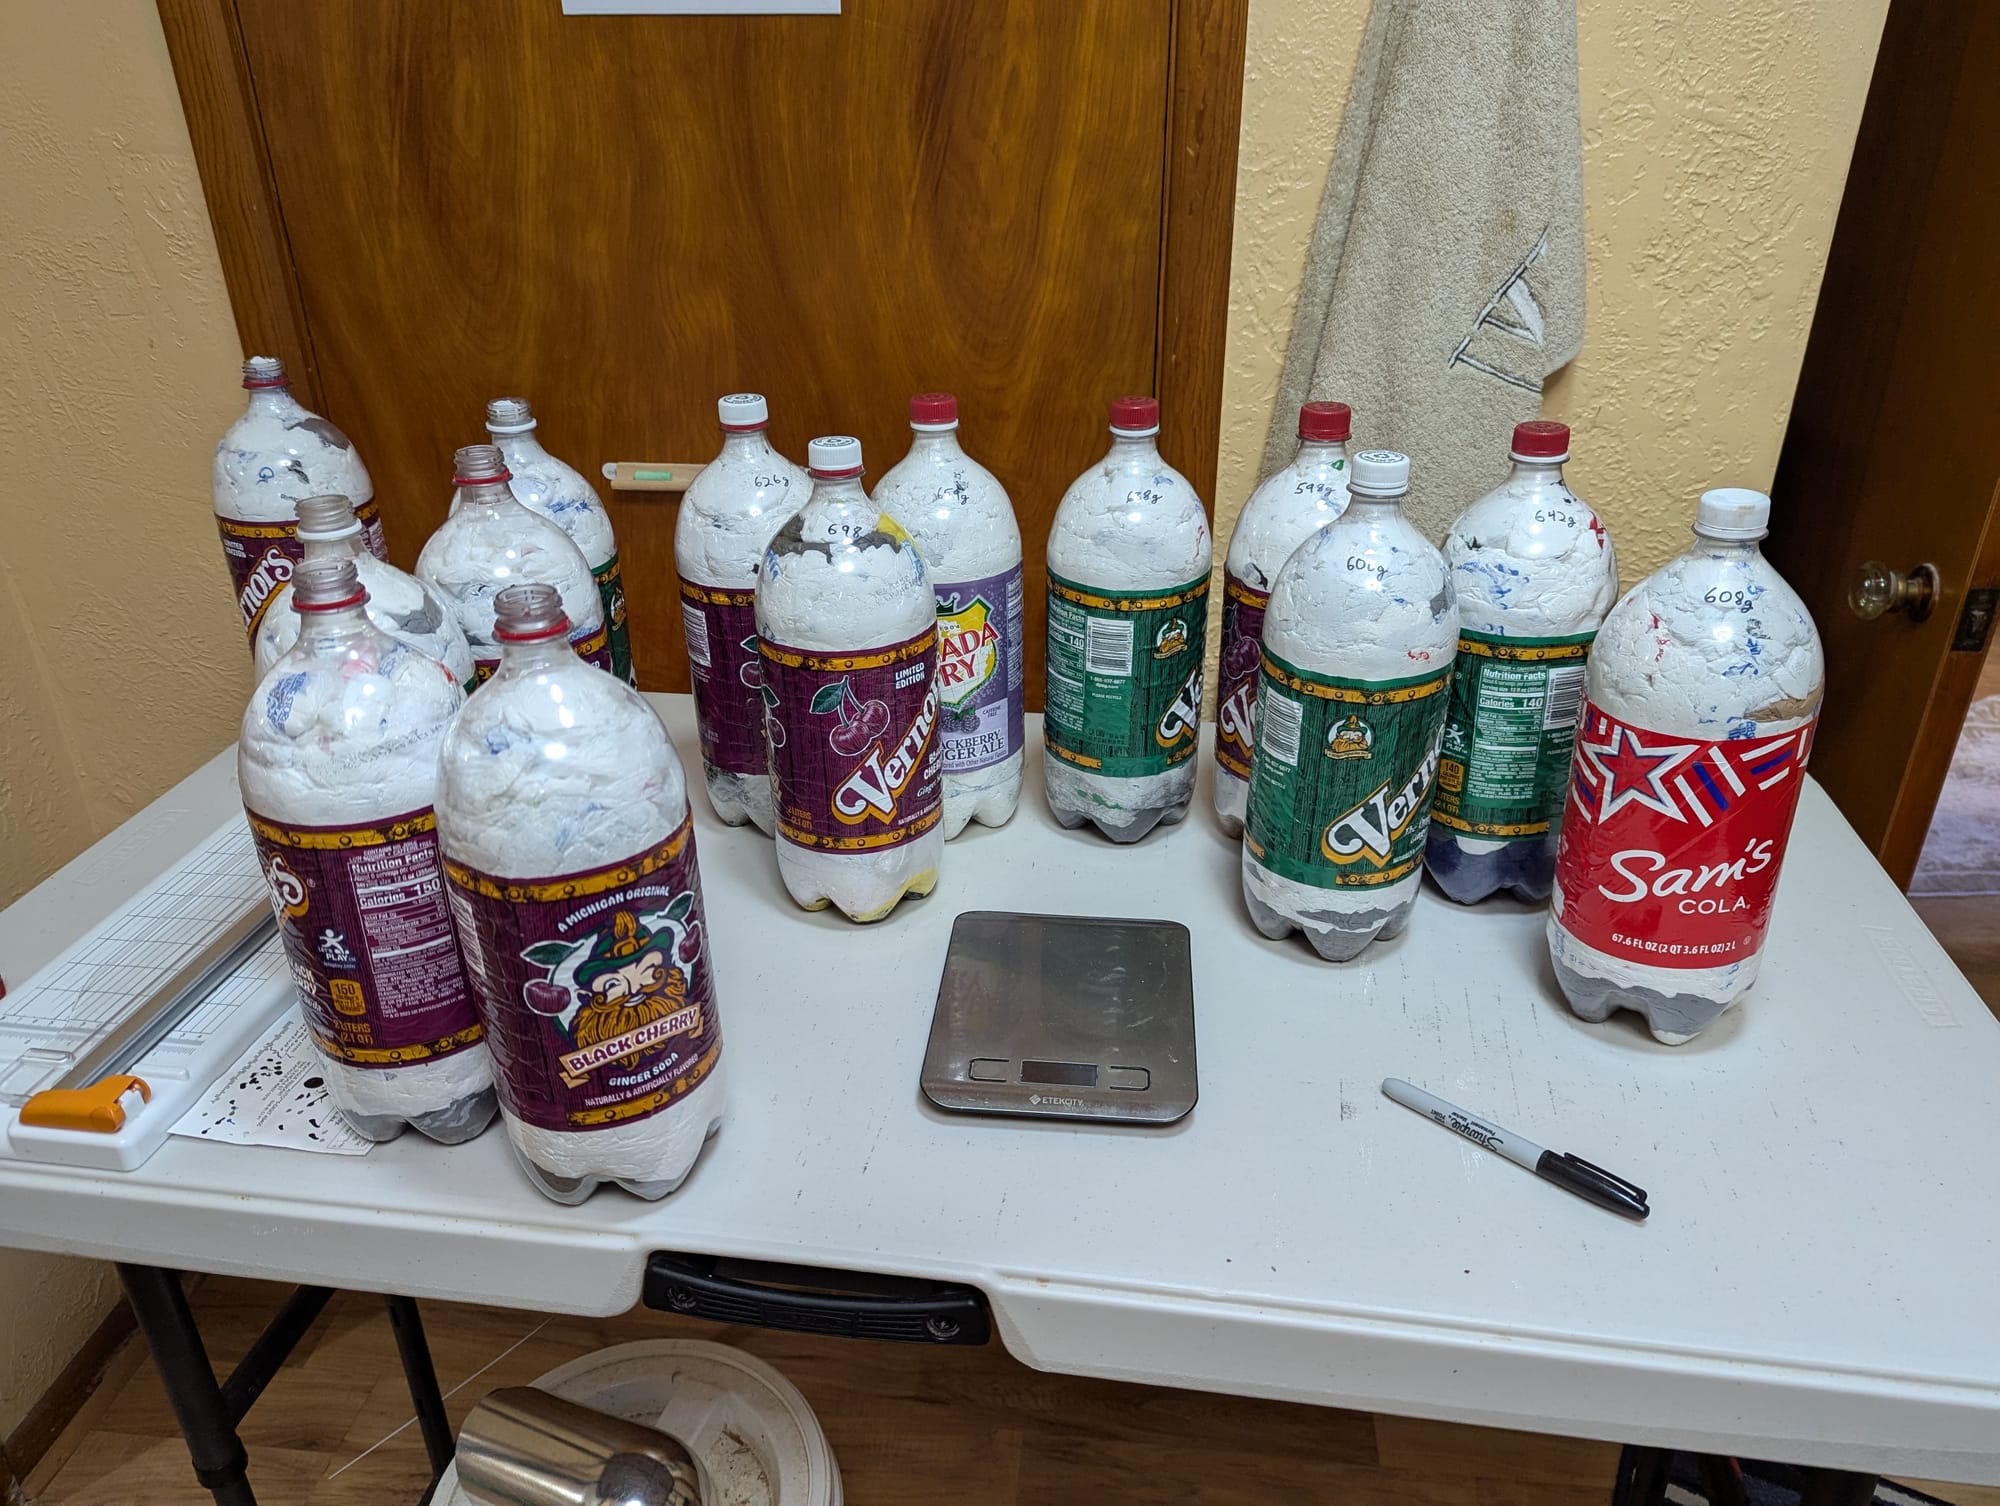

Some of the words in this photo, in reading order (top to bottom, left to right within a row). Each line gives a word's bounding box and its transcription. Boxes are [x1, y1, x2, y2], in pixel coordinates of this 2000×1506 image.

[754, 474, 790, 488] 626g
[1294, 482, 1336, 497] 598g
[1534, 510, 1577, 529] 642g
[827, 523, 863, 539] 698
[1704, 586, 1754, 614] 608g
[941, 622, 1000, 663] ADA
[1069, 636, 1084, 648] 140
[895, 661, 925, 682] LIMITED
[939, 654, 976, 688] RY
[1483, 668, 1524, 681] Nutrition
[1523, 670, 1546, 680] Facts
[895, 672, 925, 690] EDITION
[1479, 697, 1515, 708] Calories
[1522, 698, 1543, 708] 140
[941, 729, 1001, 750] ACKBERRY
[979, 736, 1006, 757] ALE
[1445, 762, 1460, 775] 140
[351, 857, 403, 875] Nutrition
[405, 848, 435, 862] Facts
[1598, 837, 1774, 903] Sam's
[359, 892, 406, 907] Calories
[411, 878, 441, 898] 150
[556, 920, 568, 934] A
[565, 892, 625, 927] MICHIGAN
[625, 884, 671, 900] ORIGINAL
[1678, 895, 1746, 915] COLA
[1611, 932, 1633, 946] 67.6
[1632, 937, 1644, 949] FL
[1644, 940, 1658, 952] OZ
[1658, 942, 1668, 954] (2
[1669, 943, 1683, 955] QT
[1683, 943, 1699, 955] 3.6
[1699, 942, 1711, 954] FL
[1711, 941, 1726, 954] OZ)
[1725, 942, 1731, 952] 2
[1731, 940, 1737, 951] L
[326, 953, 348, 963] PLAY
[335, 983, 356, 996] 150
[340, 1023, 372, 1033] LITERS
[357, 1035, 374, 1046] QT)
[567, 1033, 634, 1072] BLACK
[634, 1006, 699, 1047] CHERRY
[608, 1070, 653, 1087] GINGER
[652, 1051, 680, 1076] SODA
[584, 1091, 626, 1107] NATURALLY
[625, 1089, 633, 1099] &
[632, 1071, 675, 1097] ARTIFICIALLY
[672, 1052, 700, 1077] FLAVORED
[1042, 1096, 1084, 1106] ETEKCITY
[1451, 1111, 1468, 1122] Marker
[1450, 1117, 1504, 1152] Sharpie
[1470, 1120, 1497, 1137] Permanent
